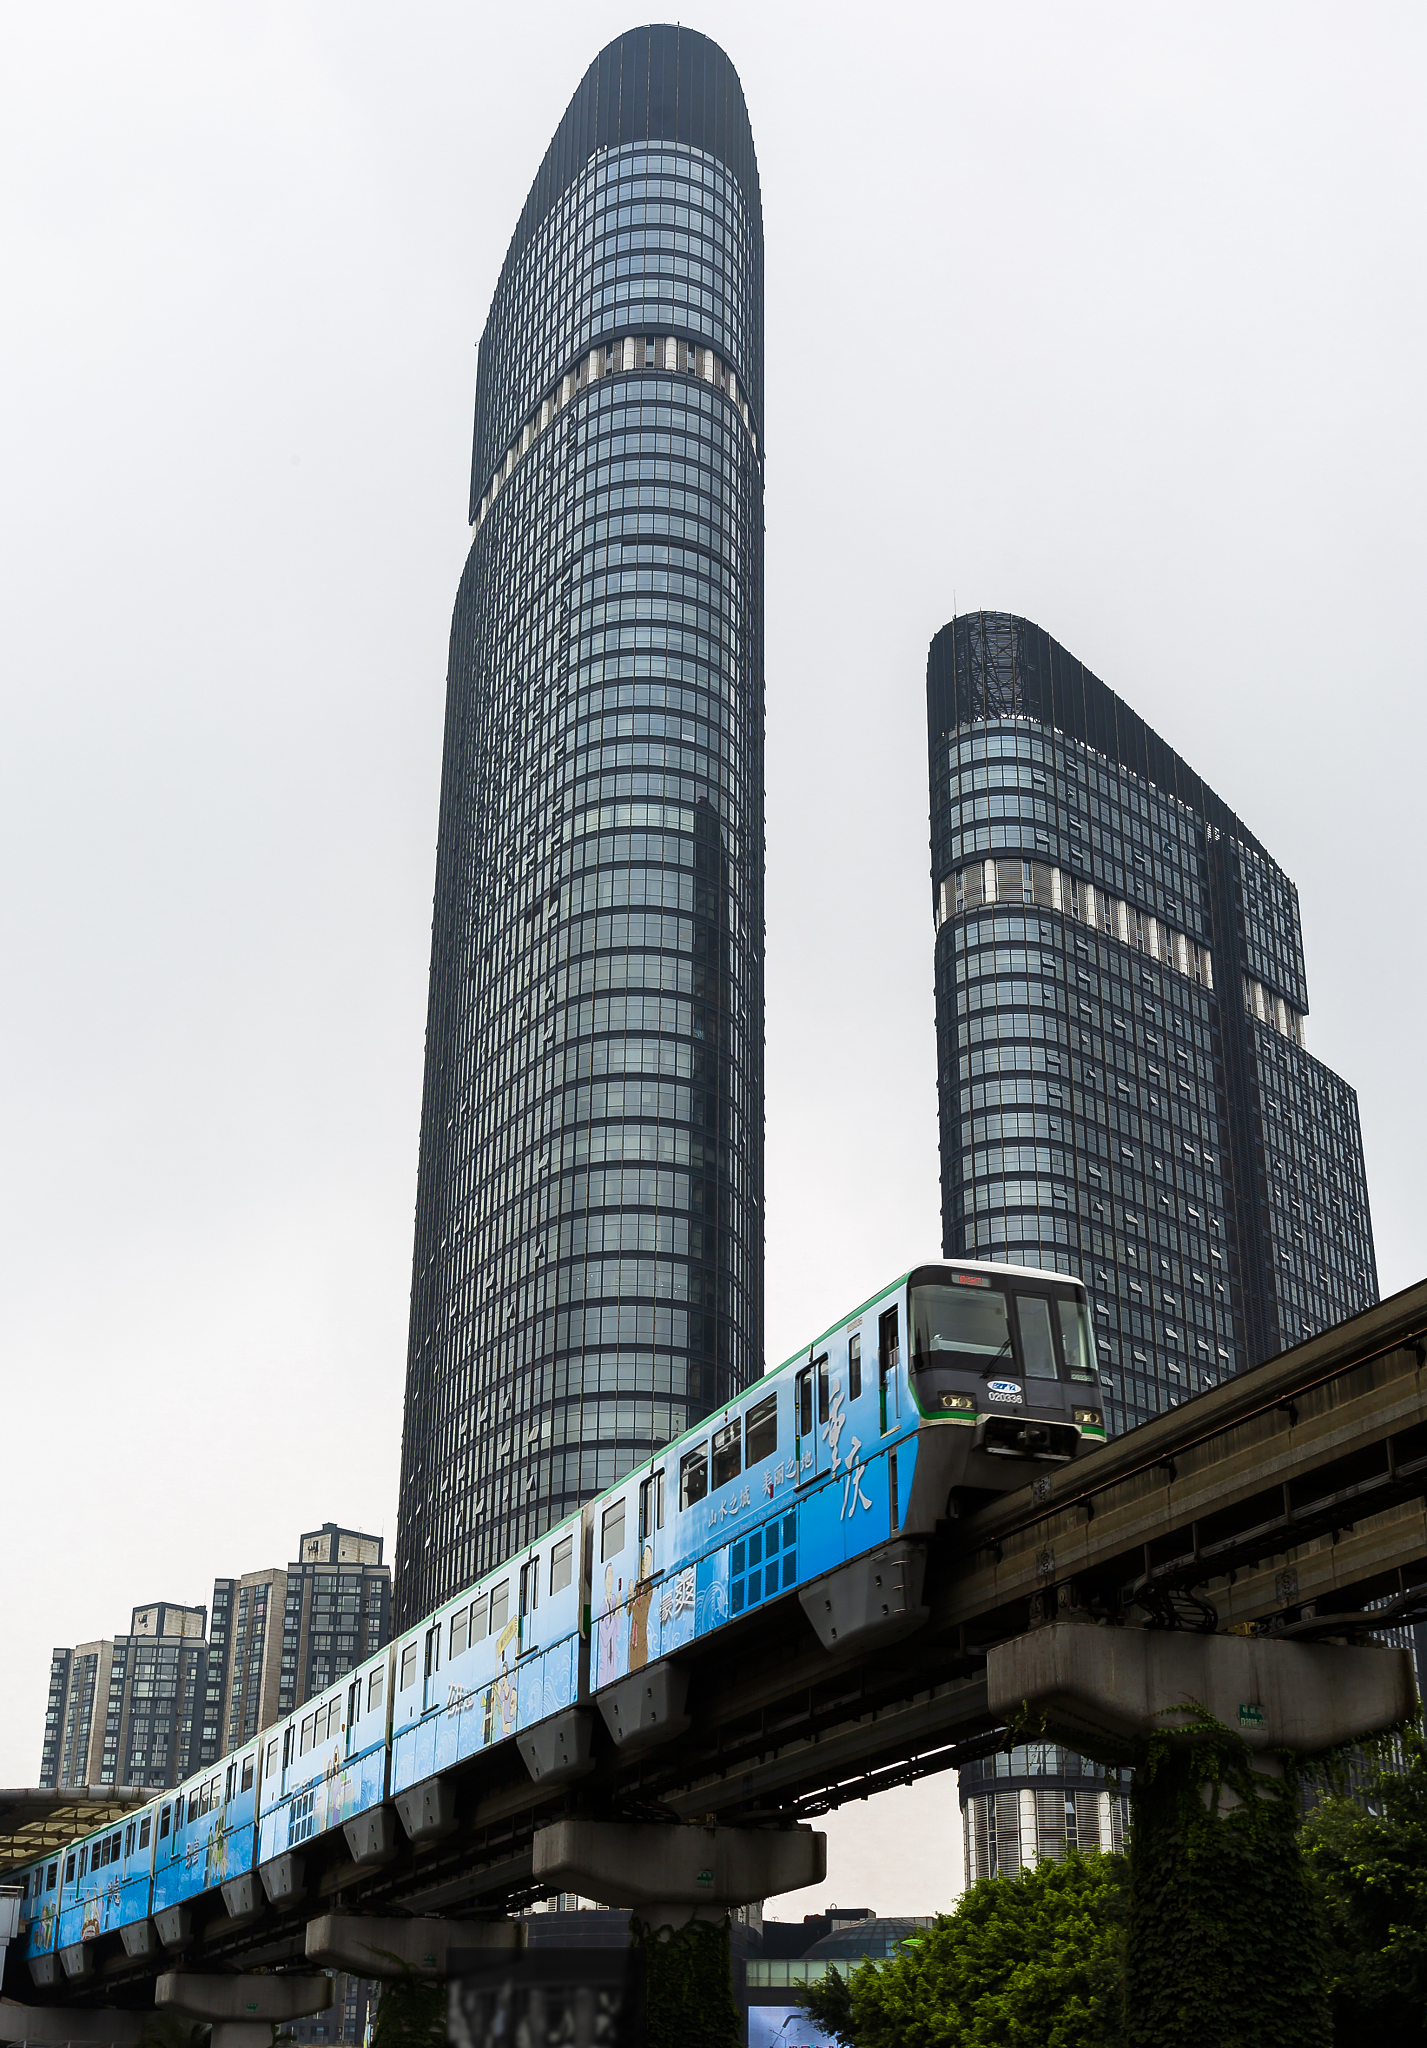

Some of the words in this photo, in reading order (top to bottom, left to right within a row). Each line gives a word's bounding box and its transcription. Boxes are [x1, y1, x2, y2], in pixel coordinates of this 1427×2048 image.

[822, 1378, 872, 1521] 重庆
[707, 1485, 751, 1528] 山水之城
[761, 1450, 813, 1497] 美丽之地
[659, 1568, 695, 1622] 豪爽
